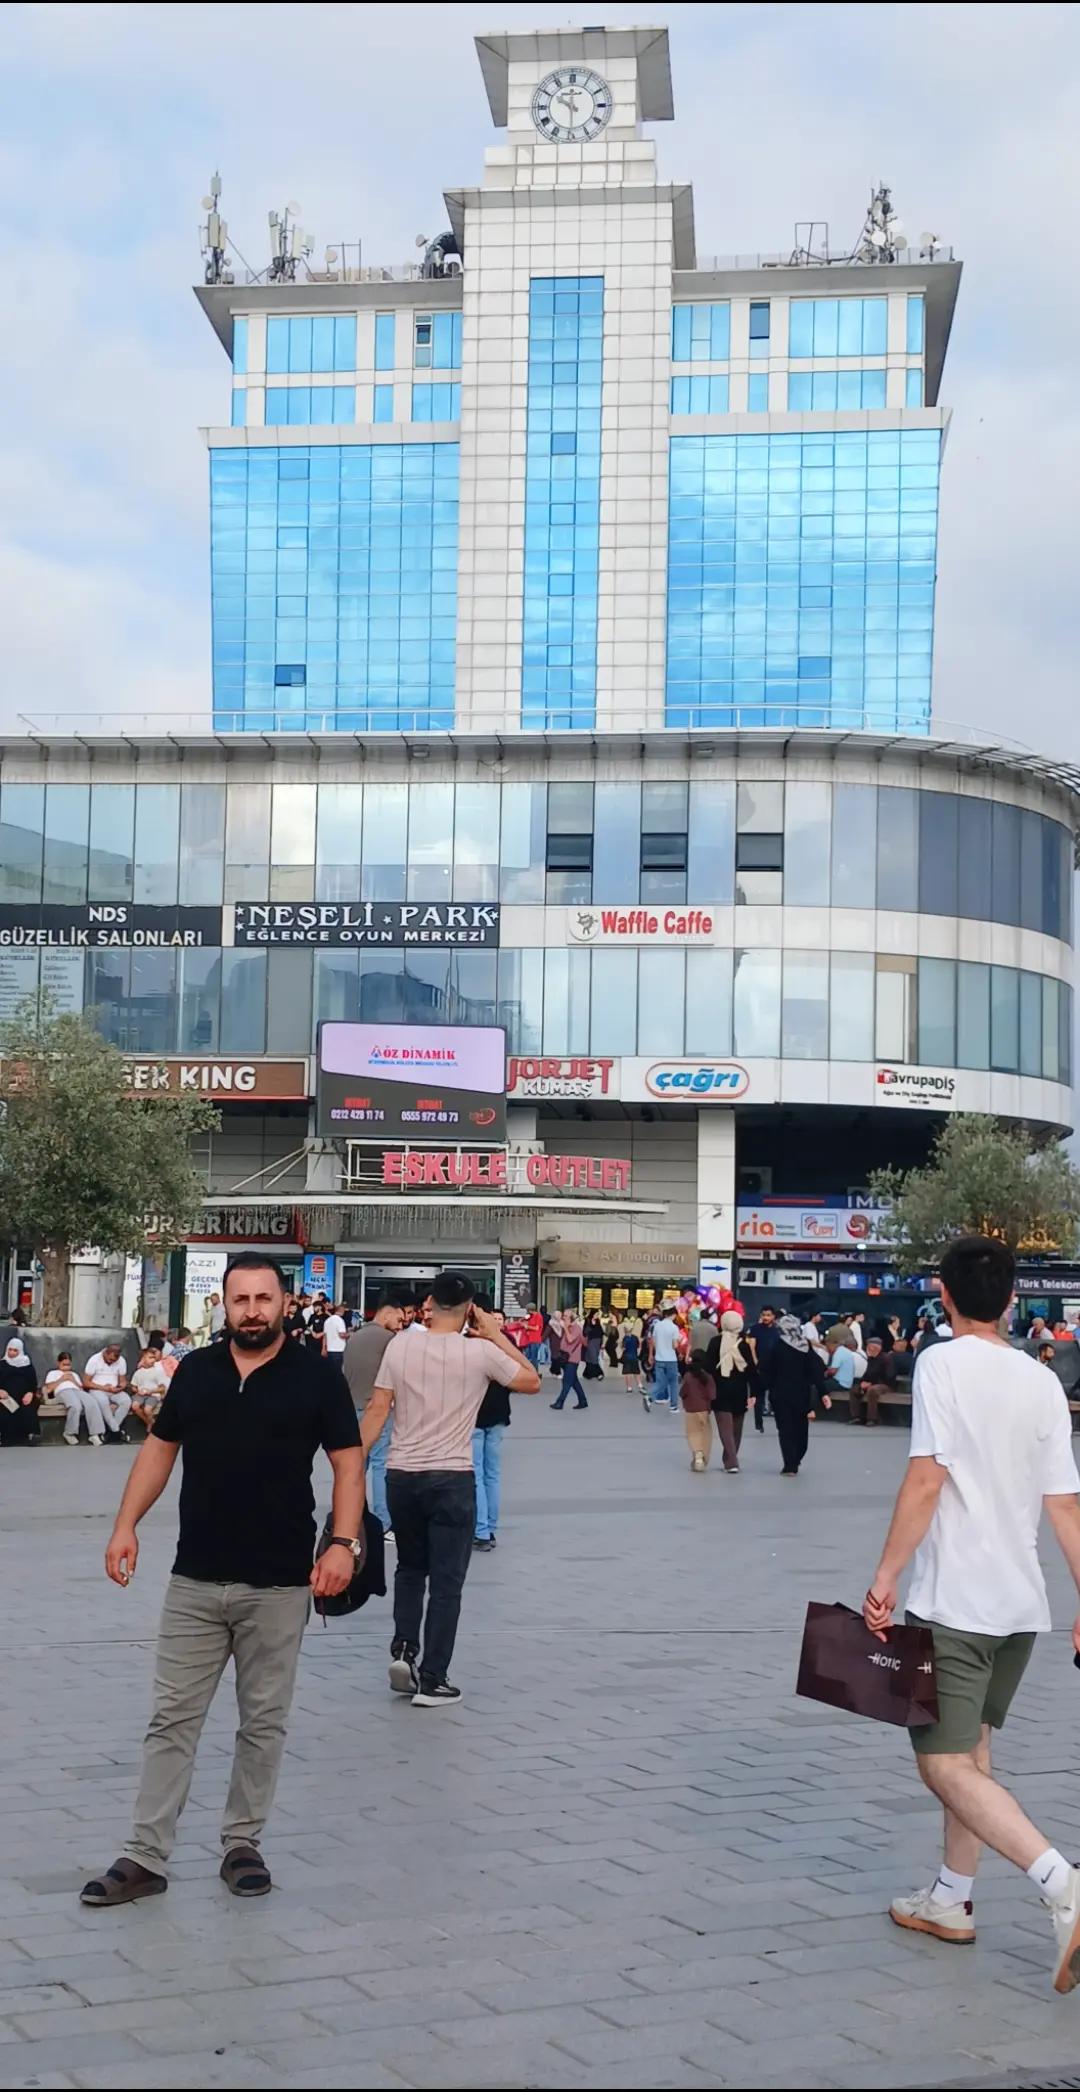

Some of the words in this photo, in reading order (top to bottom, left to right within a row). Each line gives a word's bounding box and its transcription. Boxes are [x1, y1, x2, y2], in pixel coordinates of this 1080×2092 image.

[88, 906, 128, 923] NDS
[248, 902, 375, 930] NEŞELİ
[398, 905, 496, 928] PARK
[601, 910, 658, 934] Waffle
[664, 910, 712, 935] Caffe
[0, 926, 89, 946] GÜZELLİK
[97, 929, 203, 946] SALONLARI
[246, 928, 330, 941] EĞLENCE
[339, 931, 393, 942] OYUN
[403, 929, 486, 942] MERKEZİ
[383, 1045, 399, 1060] ÖZ
[402, 1046, 456, 1061] DİNAMİK
[180, 1065, 257, 1091] KING
[506, 1058, 614, 1094] JORJET
[655, 1068, 740, 1093] çağrı
[523, 1078, 593, 1098] KUMAŞ
[331, 1109, 349, 1120] 0212
[383, 1152, 507, 1186] ESKULE
[526, 1154, 632, 1190] OUTLET
[229, 1215, 289, 1236] KING
[740, 1213, 774, 1236] ria
[1018, 1278, 1040, 1289] Türk
